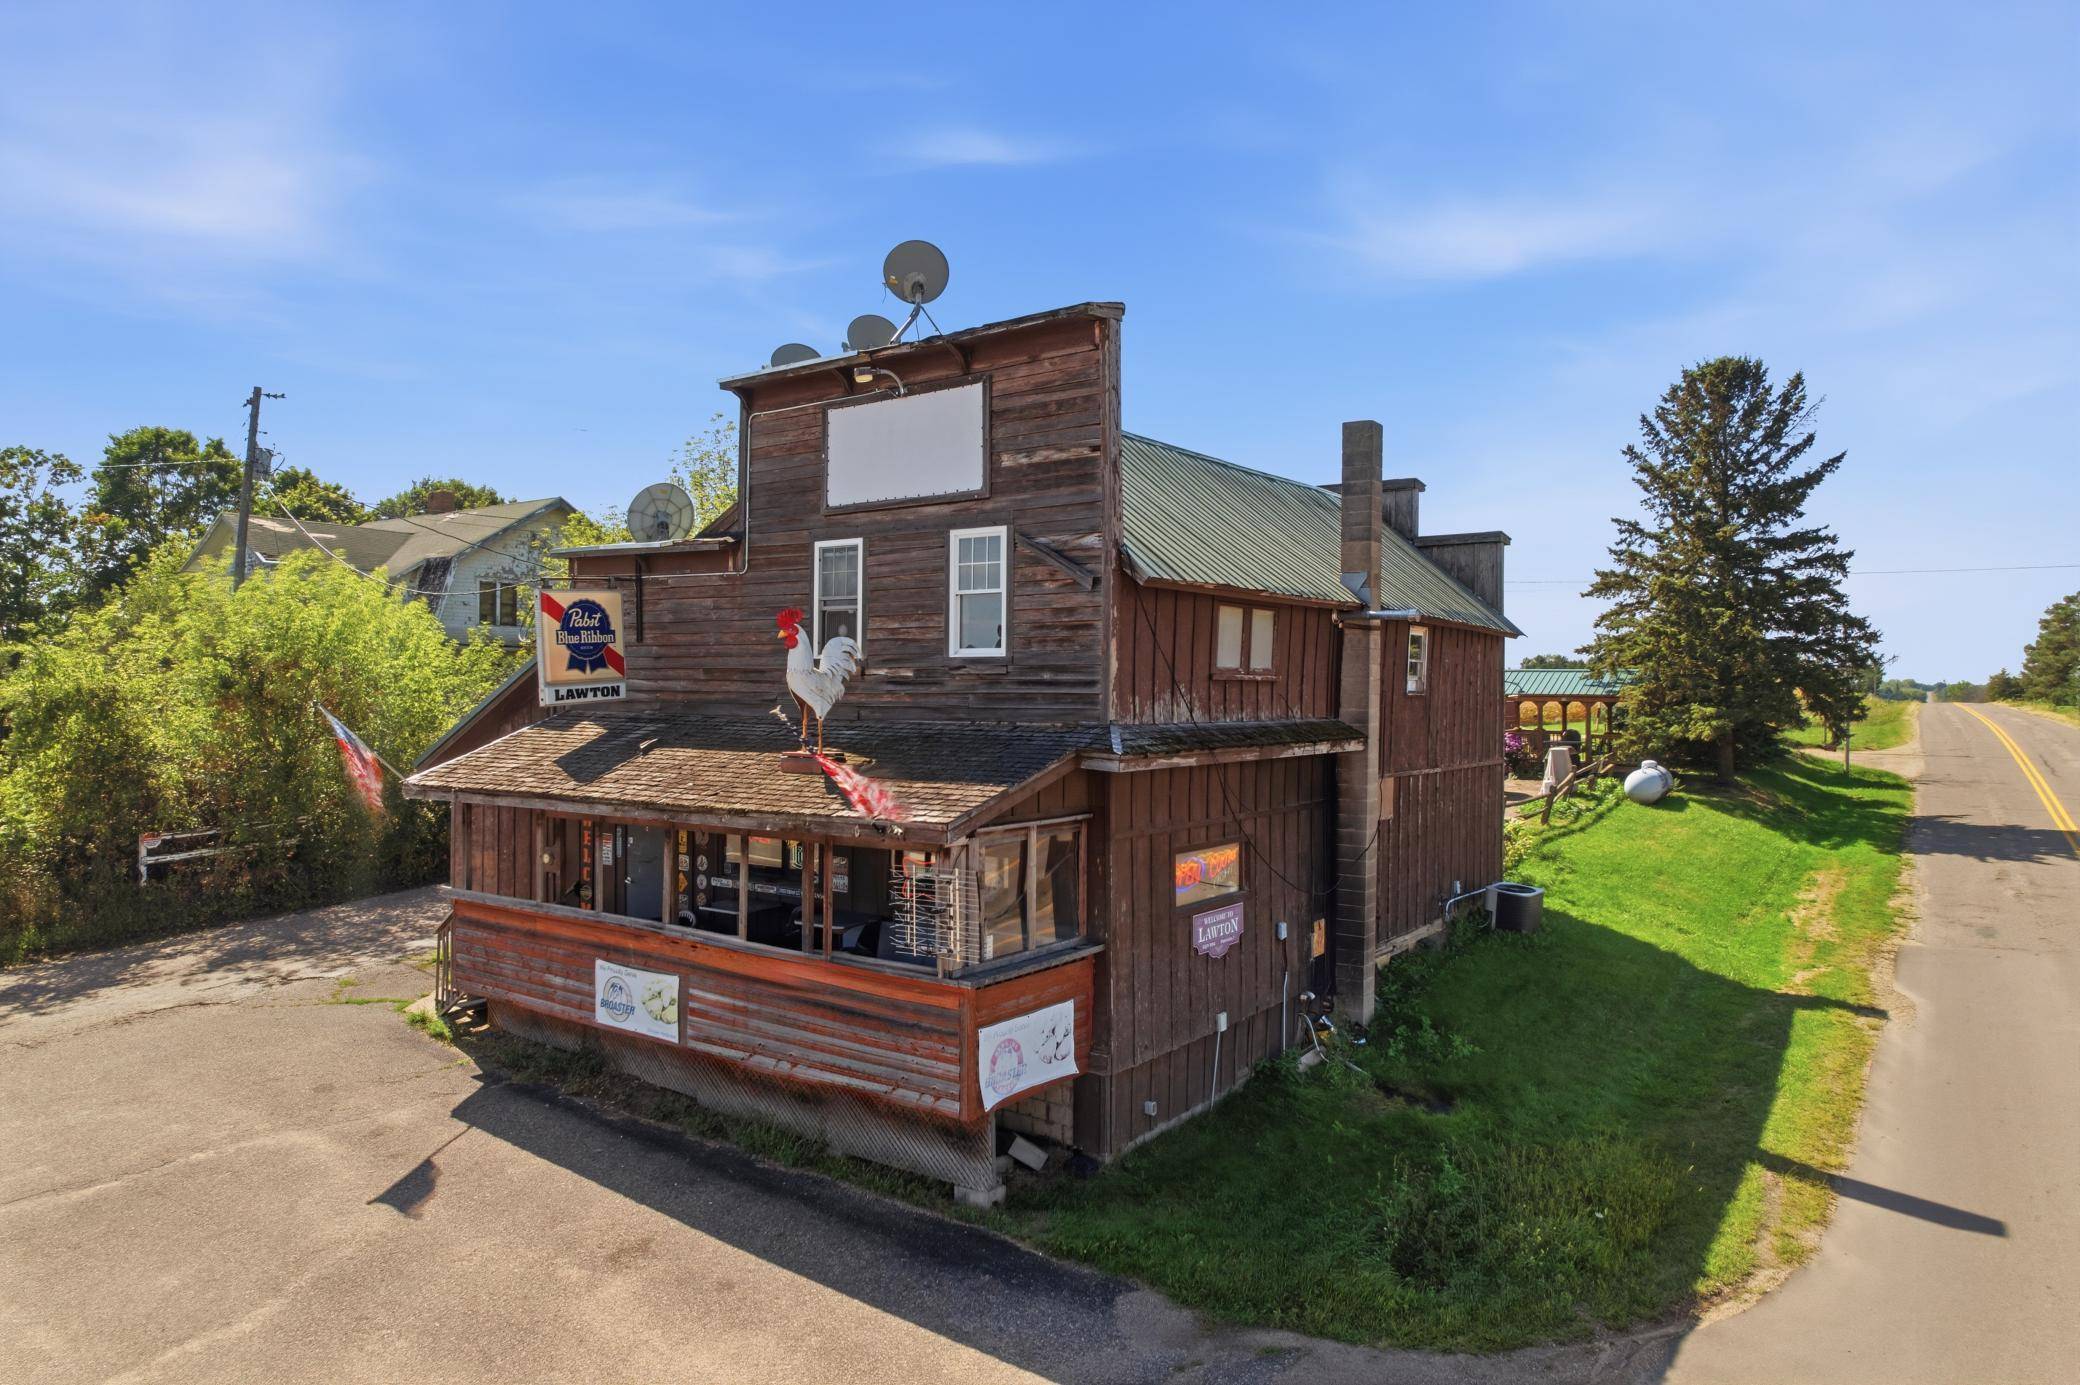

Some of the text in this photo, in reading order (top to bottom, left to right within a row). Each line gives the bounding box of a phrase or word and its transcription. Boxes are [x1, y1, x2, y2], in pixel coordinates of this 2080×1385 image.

[569, 608, 601, 627] Pabst
[557, 630, 615, 644] Blue Ribbon
[554, 685, 620, 701] LAWTON
[1203, 912, 1226, 925] WELCOME
[1199, 918, 1239, 943] LAWTON
[600, 998, 636, 1015] BROASTER
